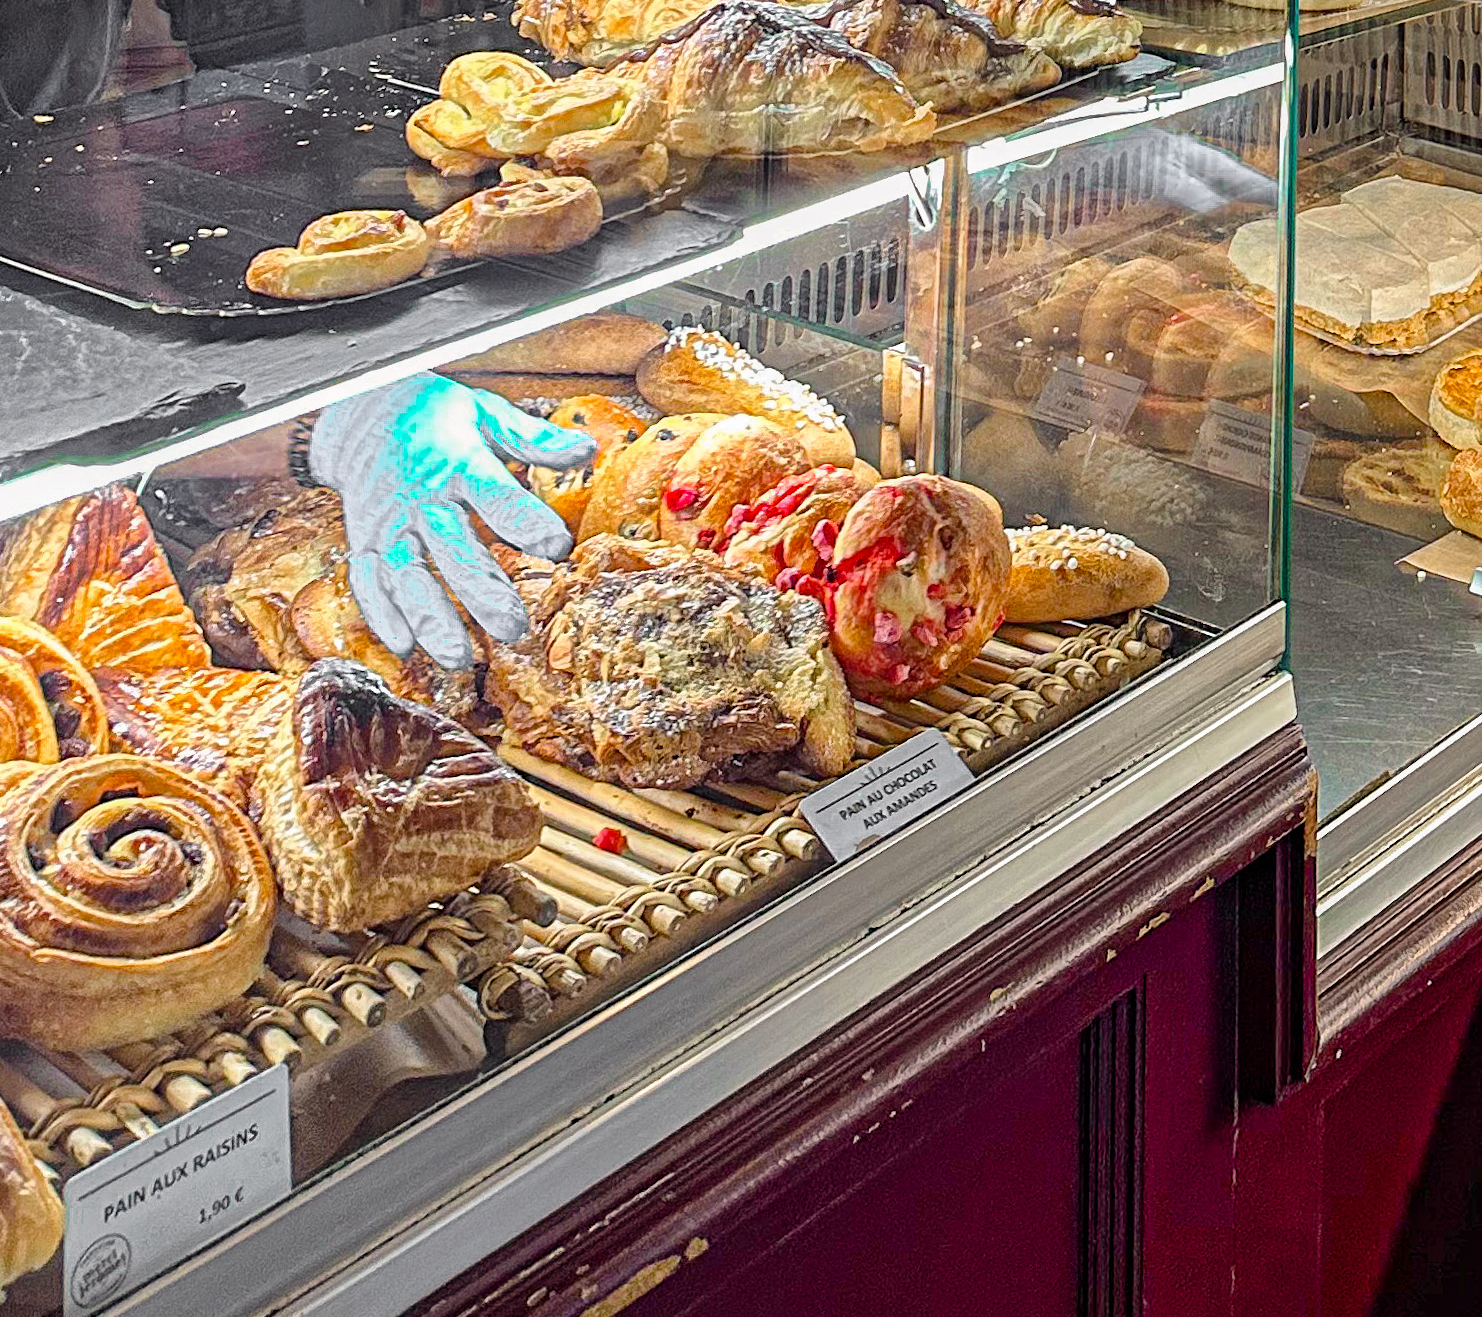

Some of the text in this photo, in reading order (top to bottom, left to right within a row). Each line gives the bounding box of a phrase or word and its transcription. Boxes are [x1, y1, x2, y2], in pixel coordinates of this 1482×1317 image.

[839, 758, 937, 820] PAIN AU CHOCOLAT
[863, 779, 939, 830] AUX AMANDES
[103, 1123, 259, 1223] PAIN AUX RAISINS
[199, 1186, 245, 1224] 1,90 €
